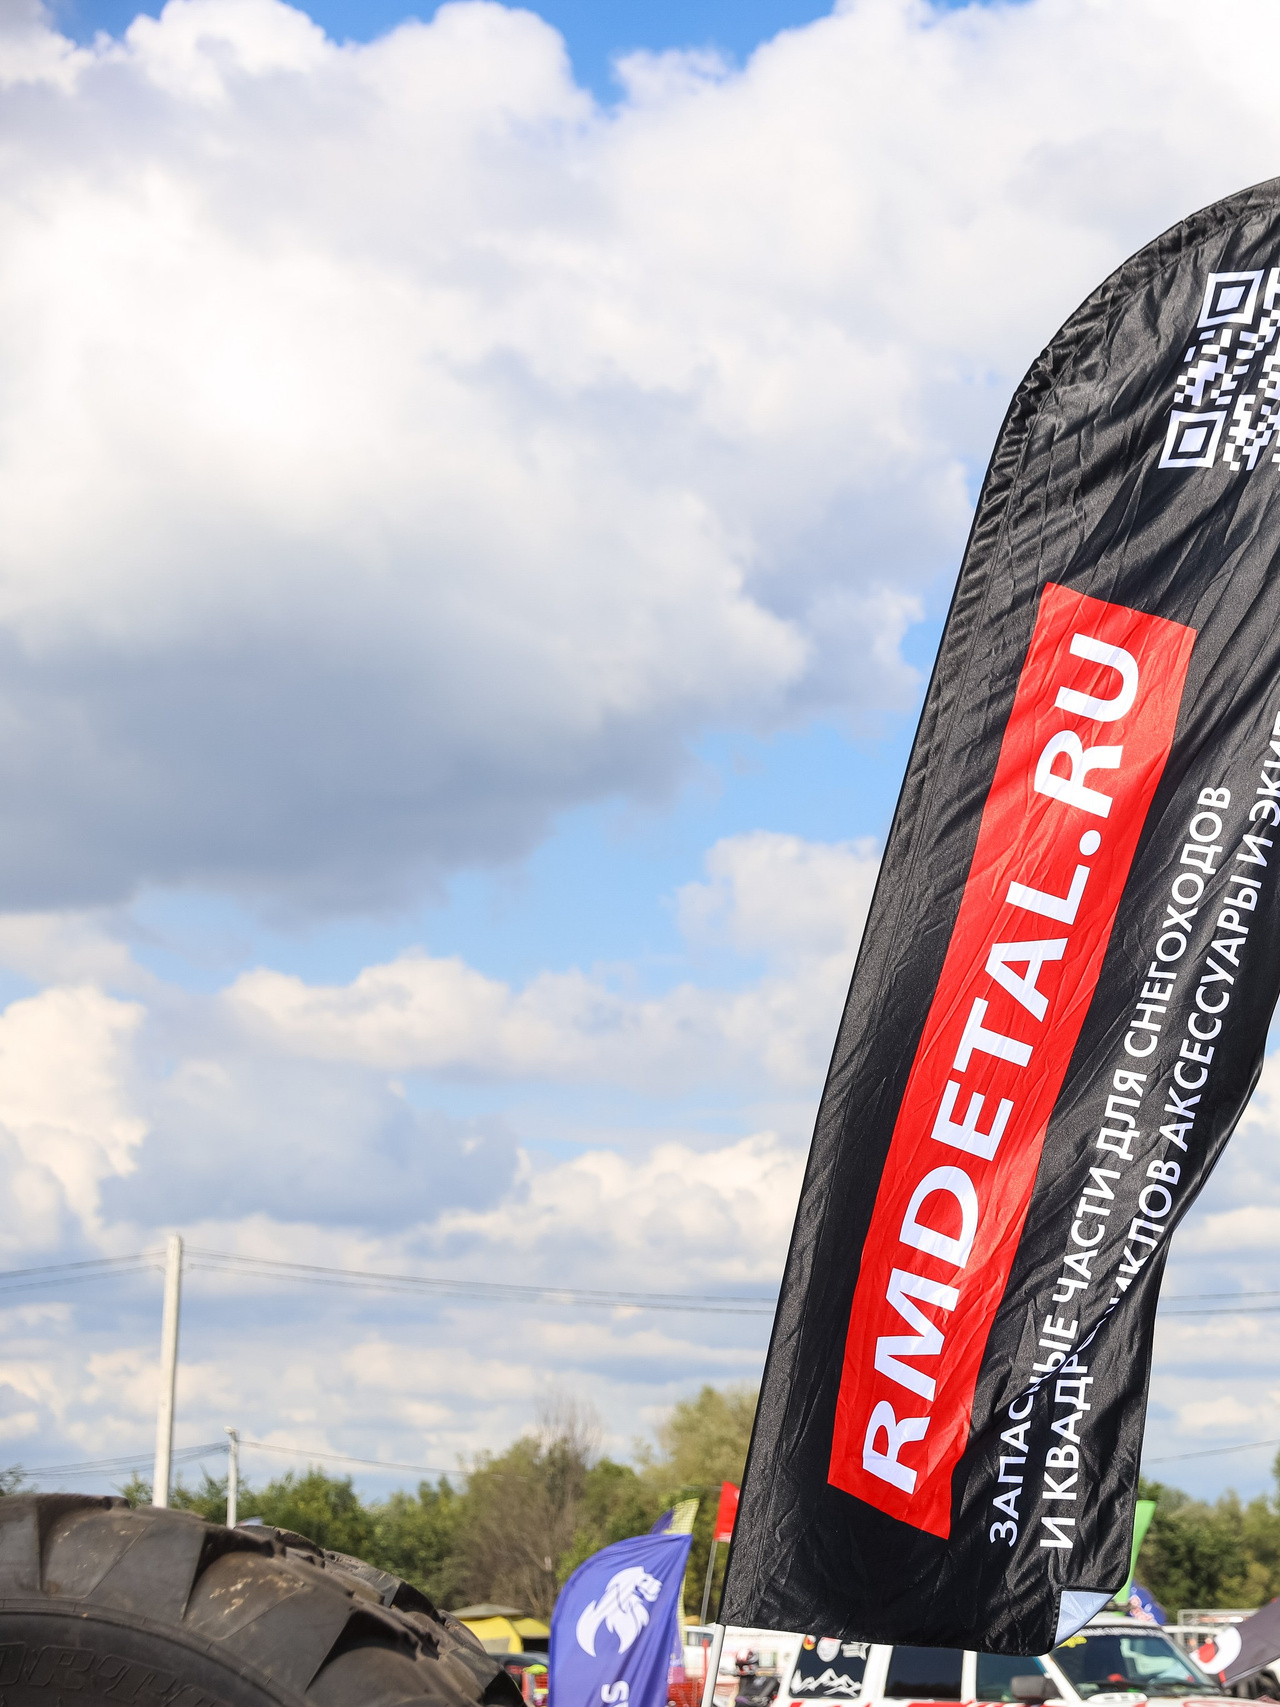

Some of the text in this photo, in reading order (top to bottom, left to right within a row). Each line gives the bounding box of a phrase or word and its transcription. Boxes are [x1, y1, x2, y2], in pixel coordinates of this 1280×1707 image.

[862, 632, 1139, 1495] RMDETAL.RU
[1039, 1516, 1075, 1550] И
[1159, 874, 1262, 1153] АКСЕССУАРЫ
[1236, 831, 1273, 868] И
[1052, 1166, 1122, 1305] ЧАСТИ
[1096, 1068, 1148, 1160] ДЛЯ
[1123, 786, 1231, 1058] СНЕГОХОДОВ
